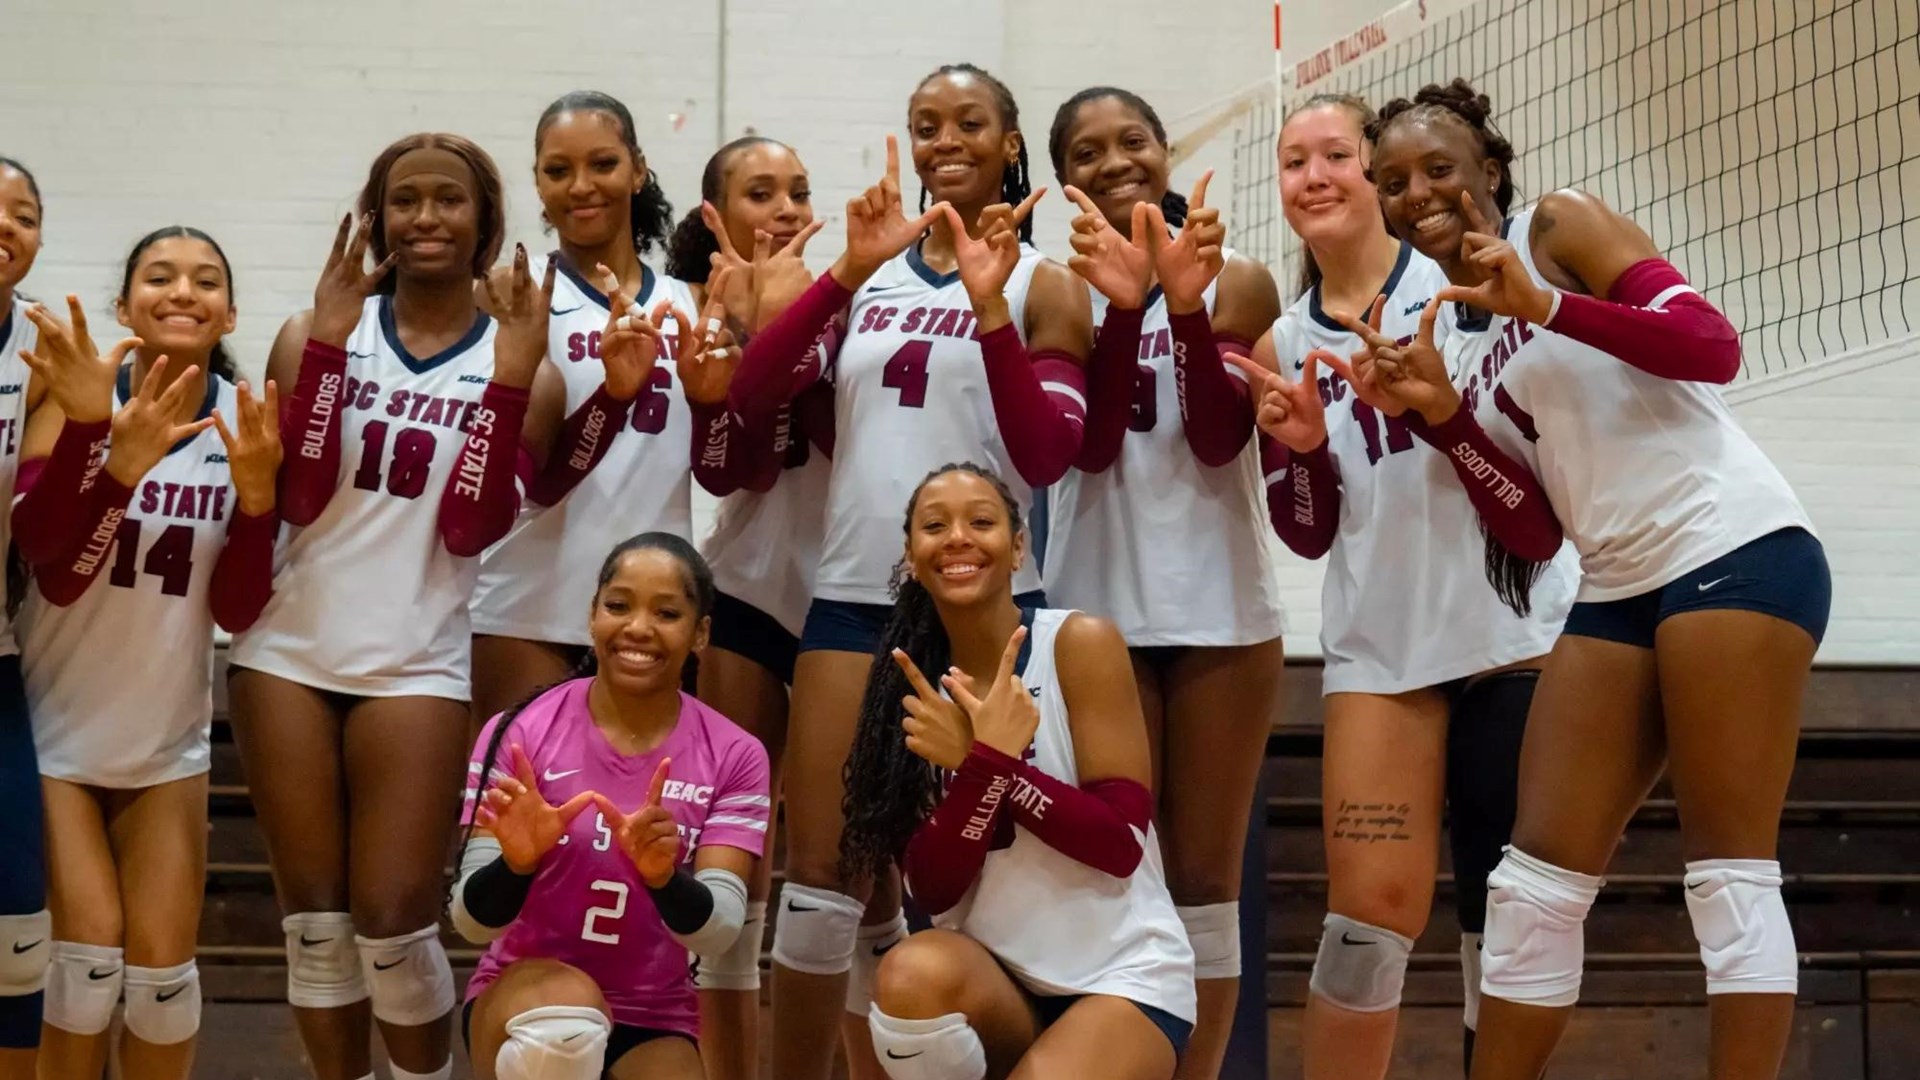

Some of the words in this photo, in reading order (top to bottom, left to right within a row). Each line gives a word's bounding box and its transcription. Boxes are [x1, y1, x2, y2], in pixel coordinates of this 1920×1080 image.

[858, 305, 899, 334] SC
[900, 306, 980, 342] STAT
[882, 339, 933, 409] 4
[301, 372, 341, 460] BULLDOGS
[473, 406, 496, 435] SC
[569, 404, 606, 470] BULLDOGS
[354, 419, 437, 500] 18
[454, 434, 490, 501] STATE
[1451, 441, 1525, 509] BULLDOGS
[139, 480, 228, 521] STATE
[1292, 463, 1314, 526] BULLDOGS
[72, 506, 126, 577] BULLDOGS
[110, 518, 196, 597] 14
[1010, 773, 1053, 820] TATE
[581, 879, 629, 944] 2
